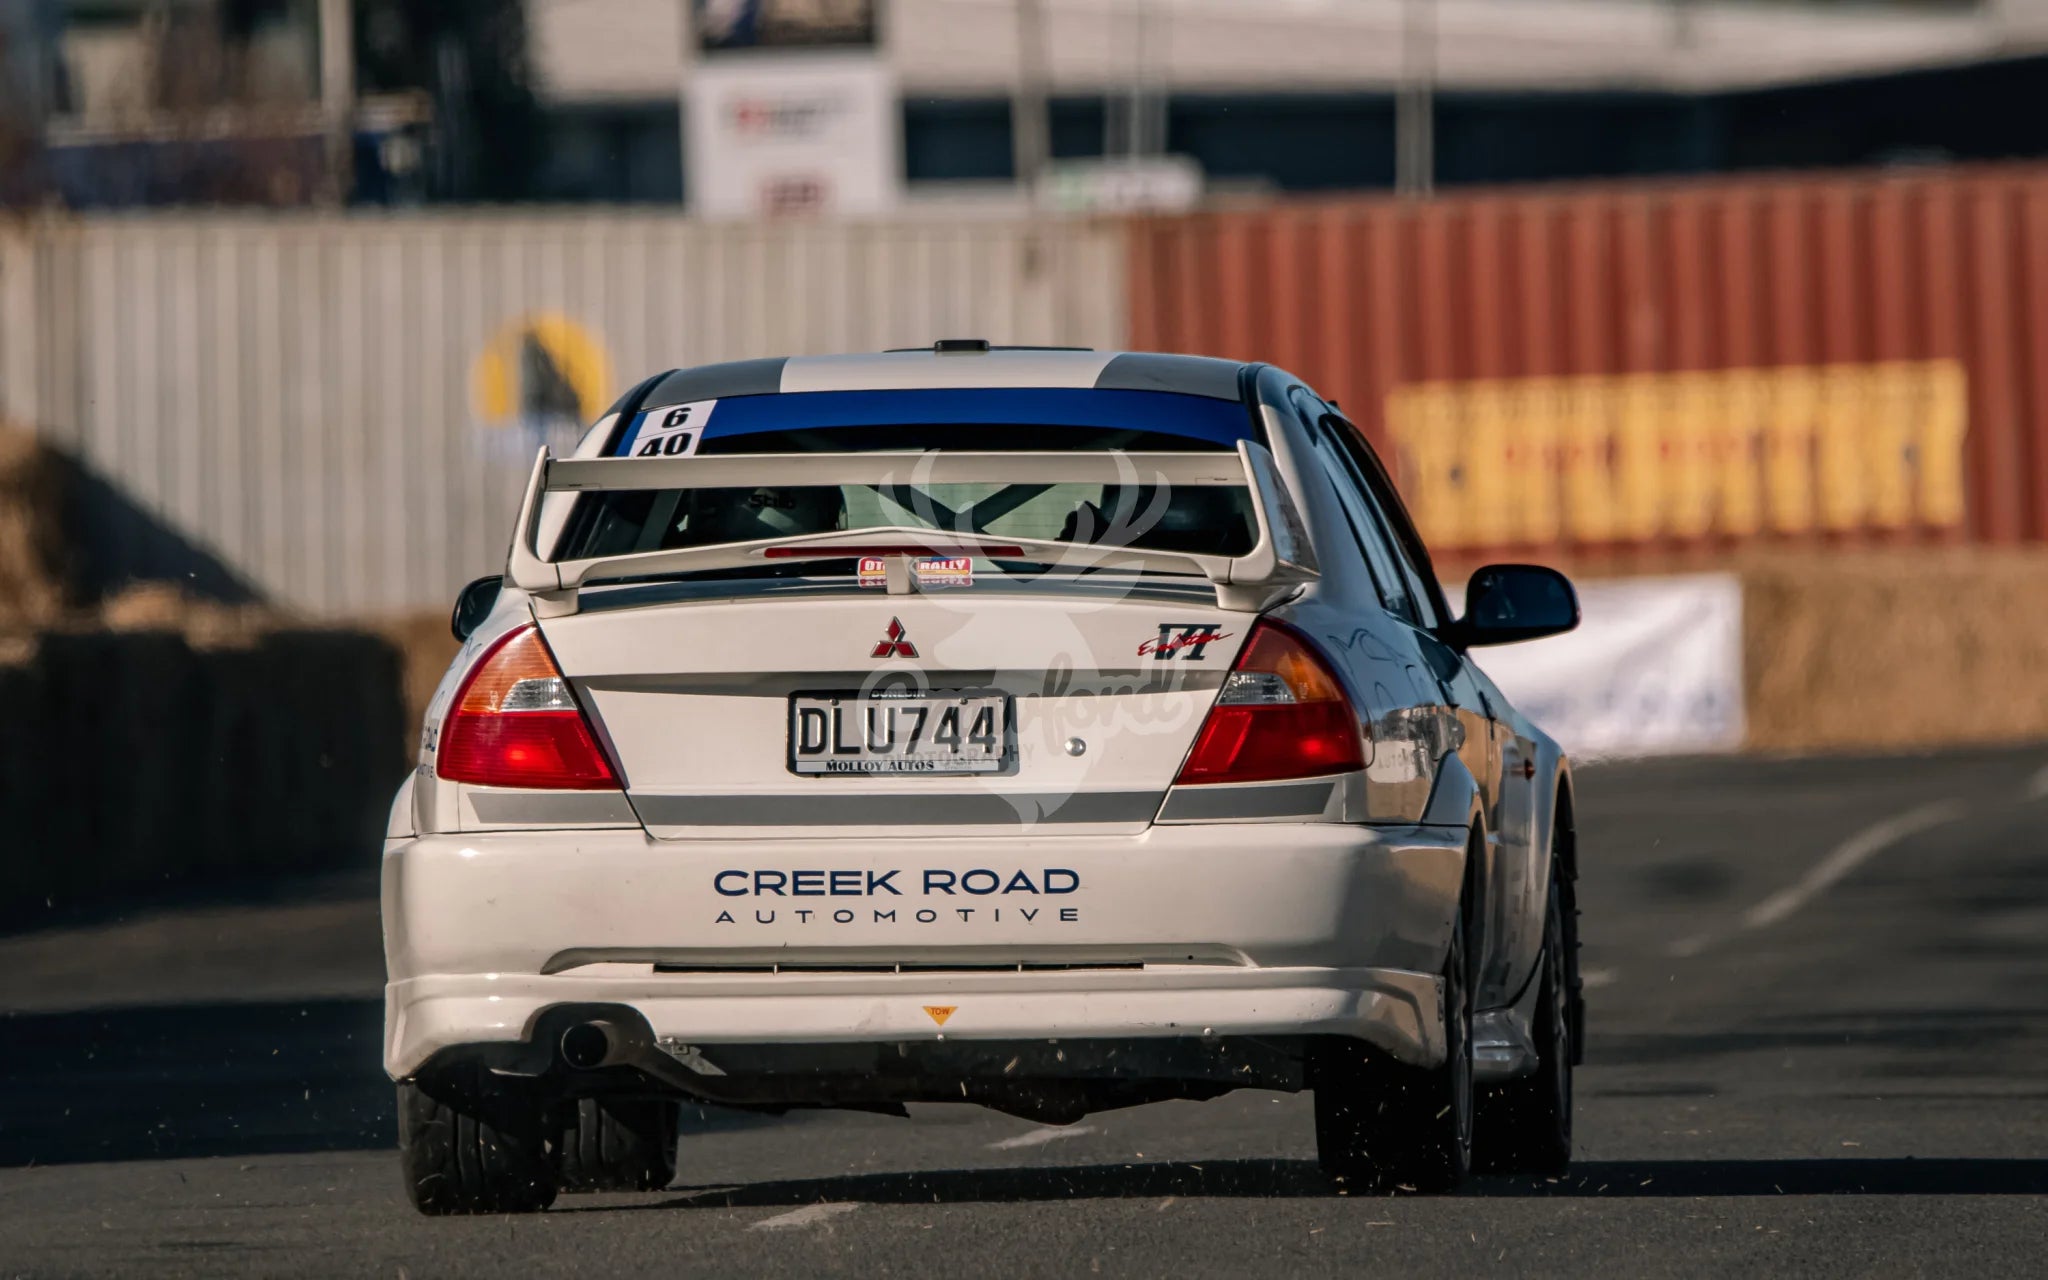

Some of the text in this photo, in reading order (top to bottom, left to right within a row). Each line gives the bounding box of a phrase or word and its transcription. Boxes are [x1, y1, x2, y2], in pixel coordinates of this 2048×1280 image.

[662, 407, 692, 428] 6
[637, 433, 692, 457] 40
[865, 560, 966, 571] OT RALLY
[797, 706, 997, 755] DLU744
[825, 760, 884, 771] MOLLOY
[888, 760, 935, 771] AUTOS
[713, 868, 1080, 896] CREEK ROAD
[714, 908, 1079, 924] AUTOMOTIVE
[930, 1007, 950, 1015] TOW
